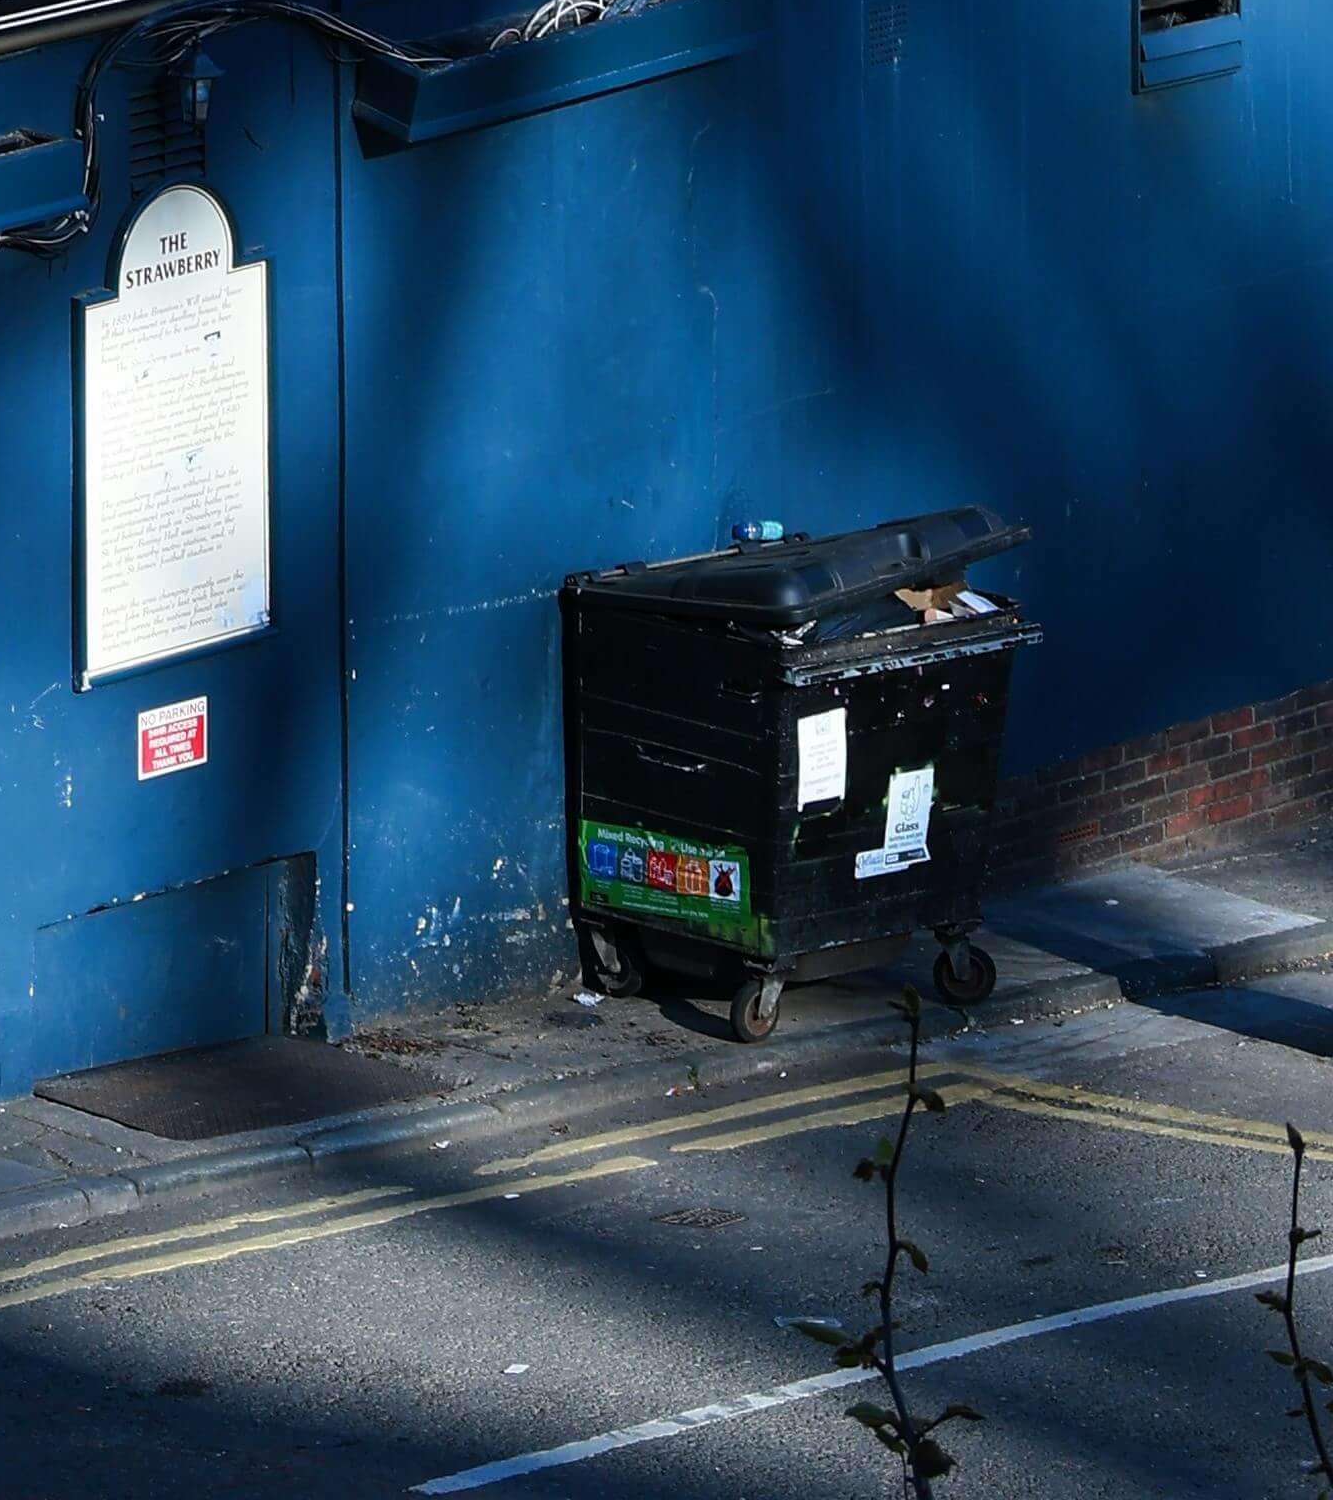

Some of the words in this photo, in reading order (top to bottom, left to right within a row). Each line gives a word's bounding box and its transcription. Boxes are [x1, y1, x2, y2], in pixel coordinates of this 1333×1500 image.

[159, 232, 189, 255] THE
[125, 249, 222, 289] STRAWBERRY
[141, 714, 156, 727] NO
[159, 701, 204, 723] PARKING
[168, 718, 197, 733] ACCESS
[154, 747, 168, 757] ALL
[152, 757, 177, 769] THANK
[178, 752, 194, 764] YOU
[597, 828, 624, 841] Mixed
[895, 821, 920, 834] Glass
